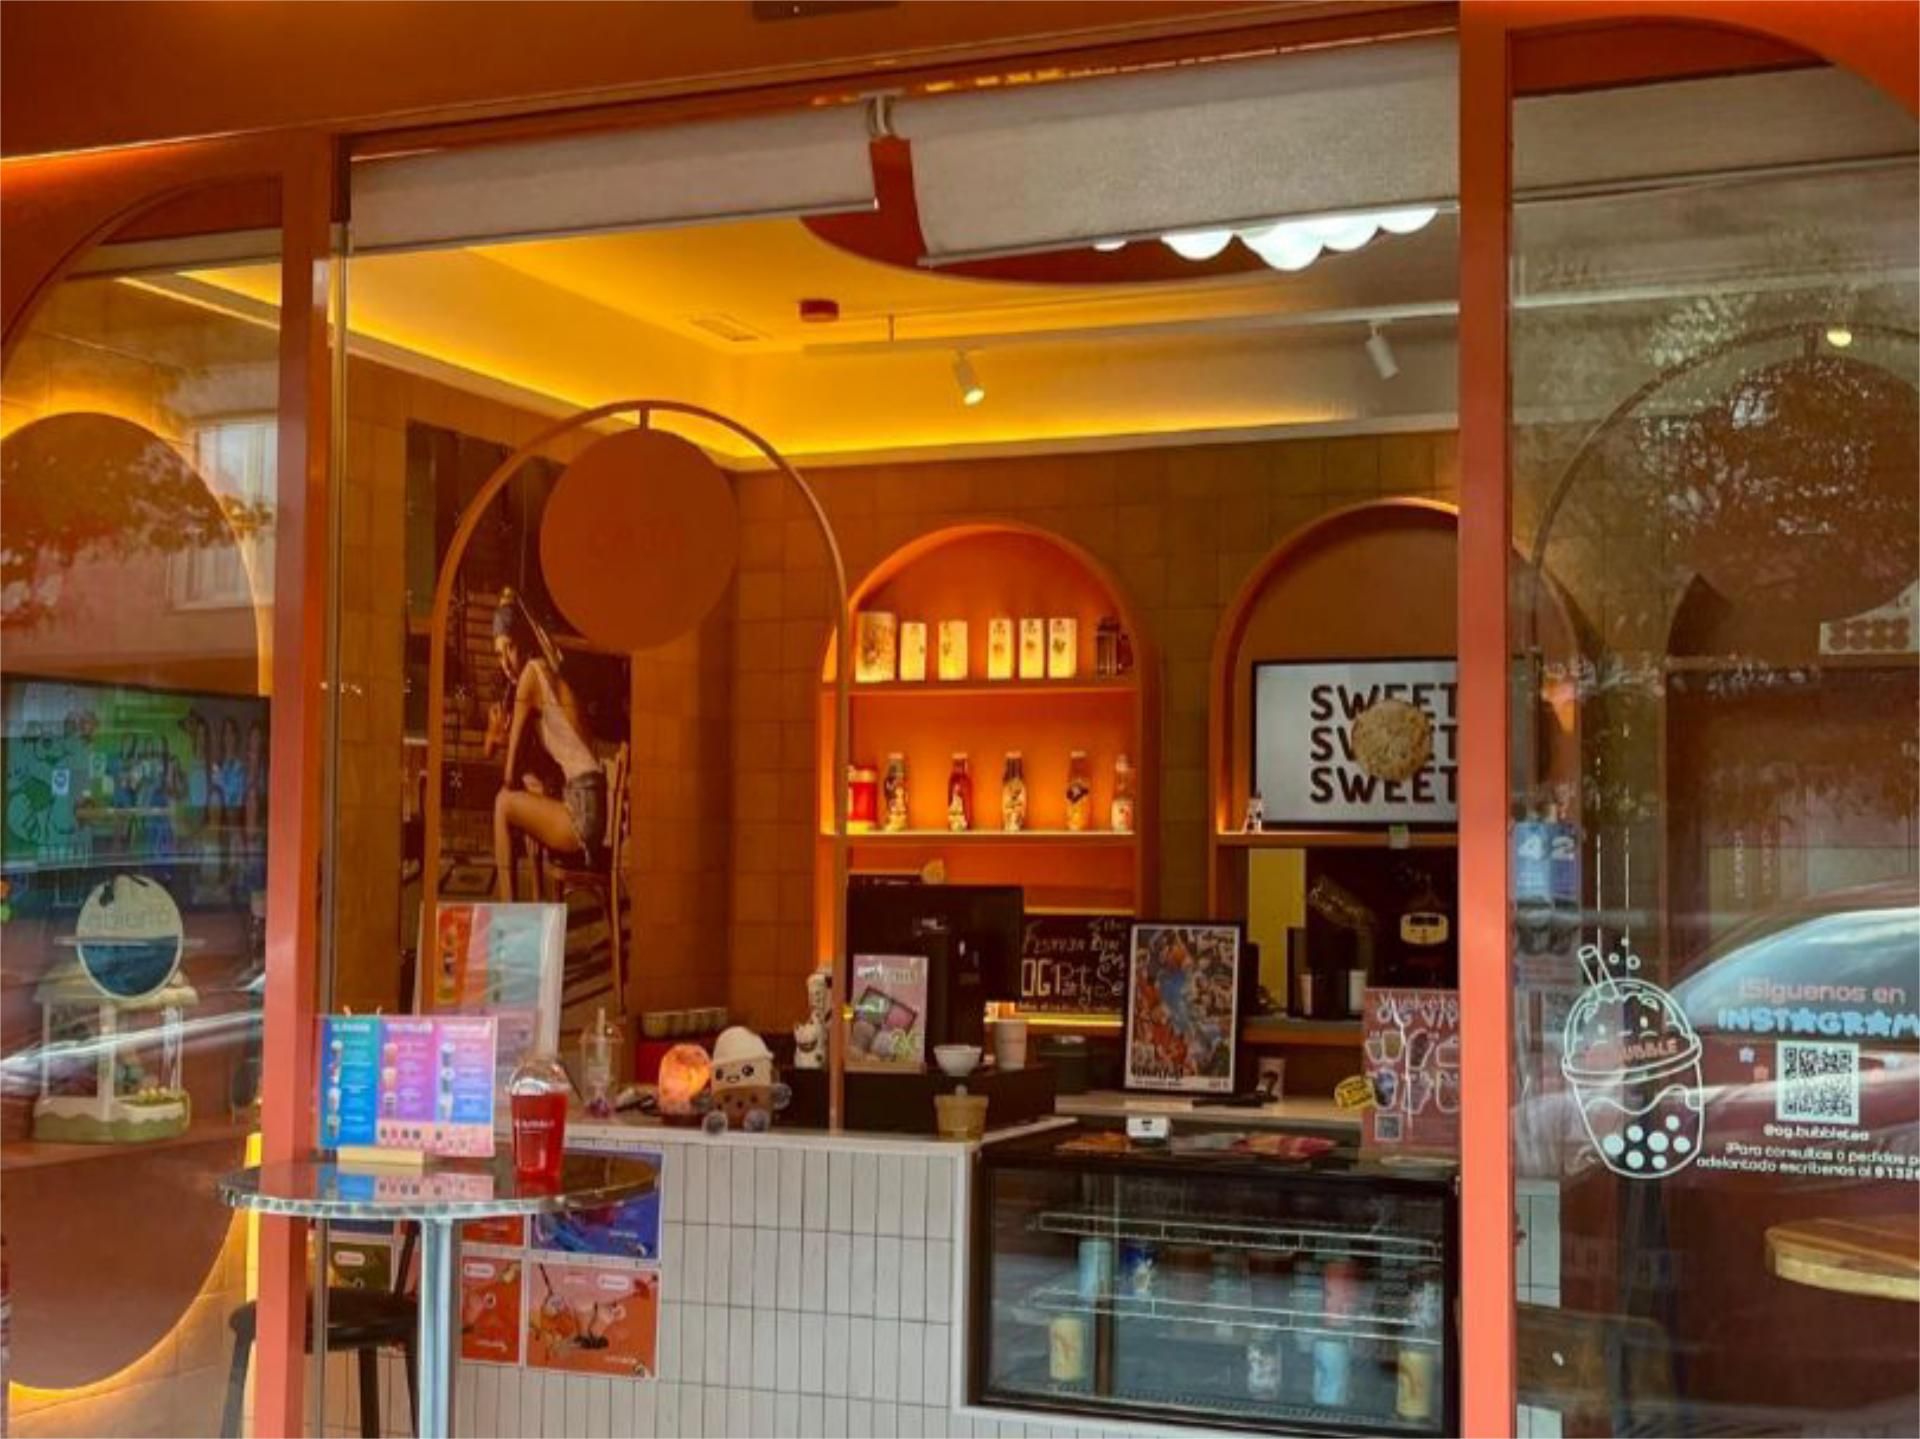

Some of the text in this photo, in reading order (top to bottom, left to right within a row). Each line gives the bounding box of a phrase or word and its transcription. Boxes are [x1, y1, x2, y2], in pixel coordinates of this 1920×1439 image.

[1871, 983, 1907, 1005] en
[1697, 1155, 1776, 1173] adelantado
[1859, 1164, 1872, 1177] al
[1766, 1146, 1833, 1161] consultas
[1848, 1149, 1906, 1166] pedidos
